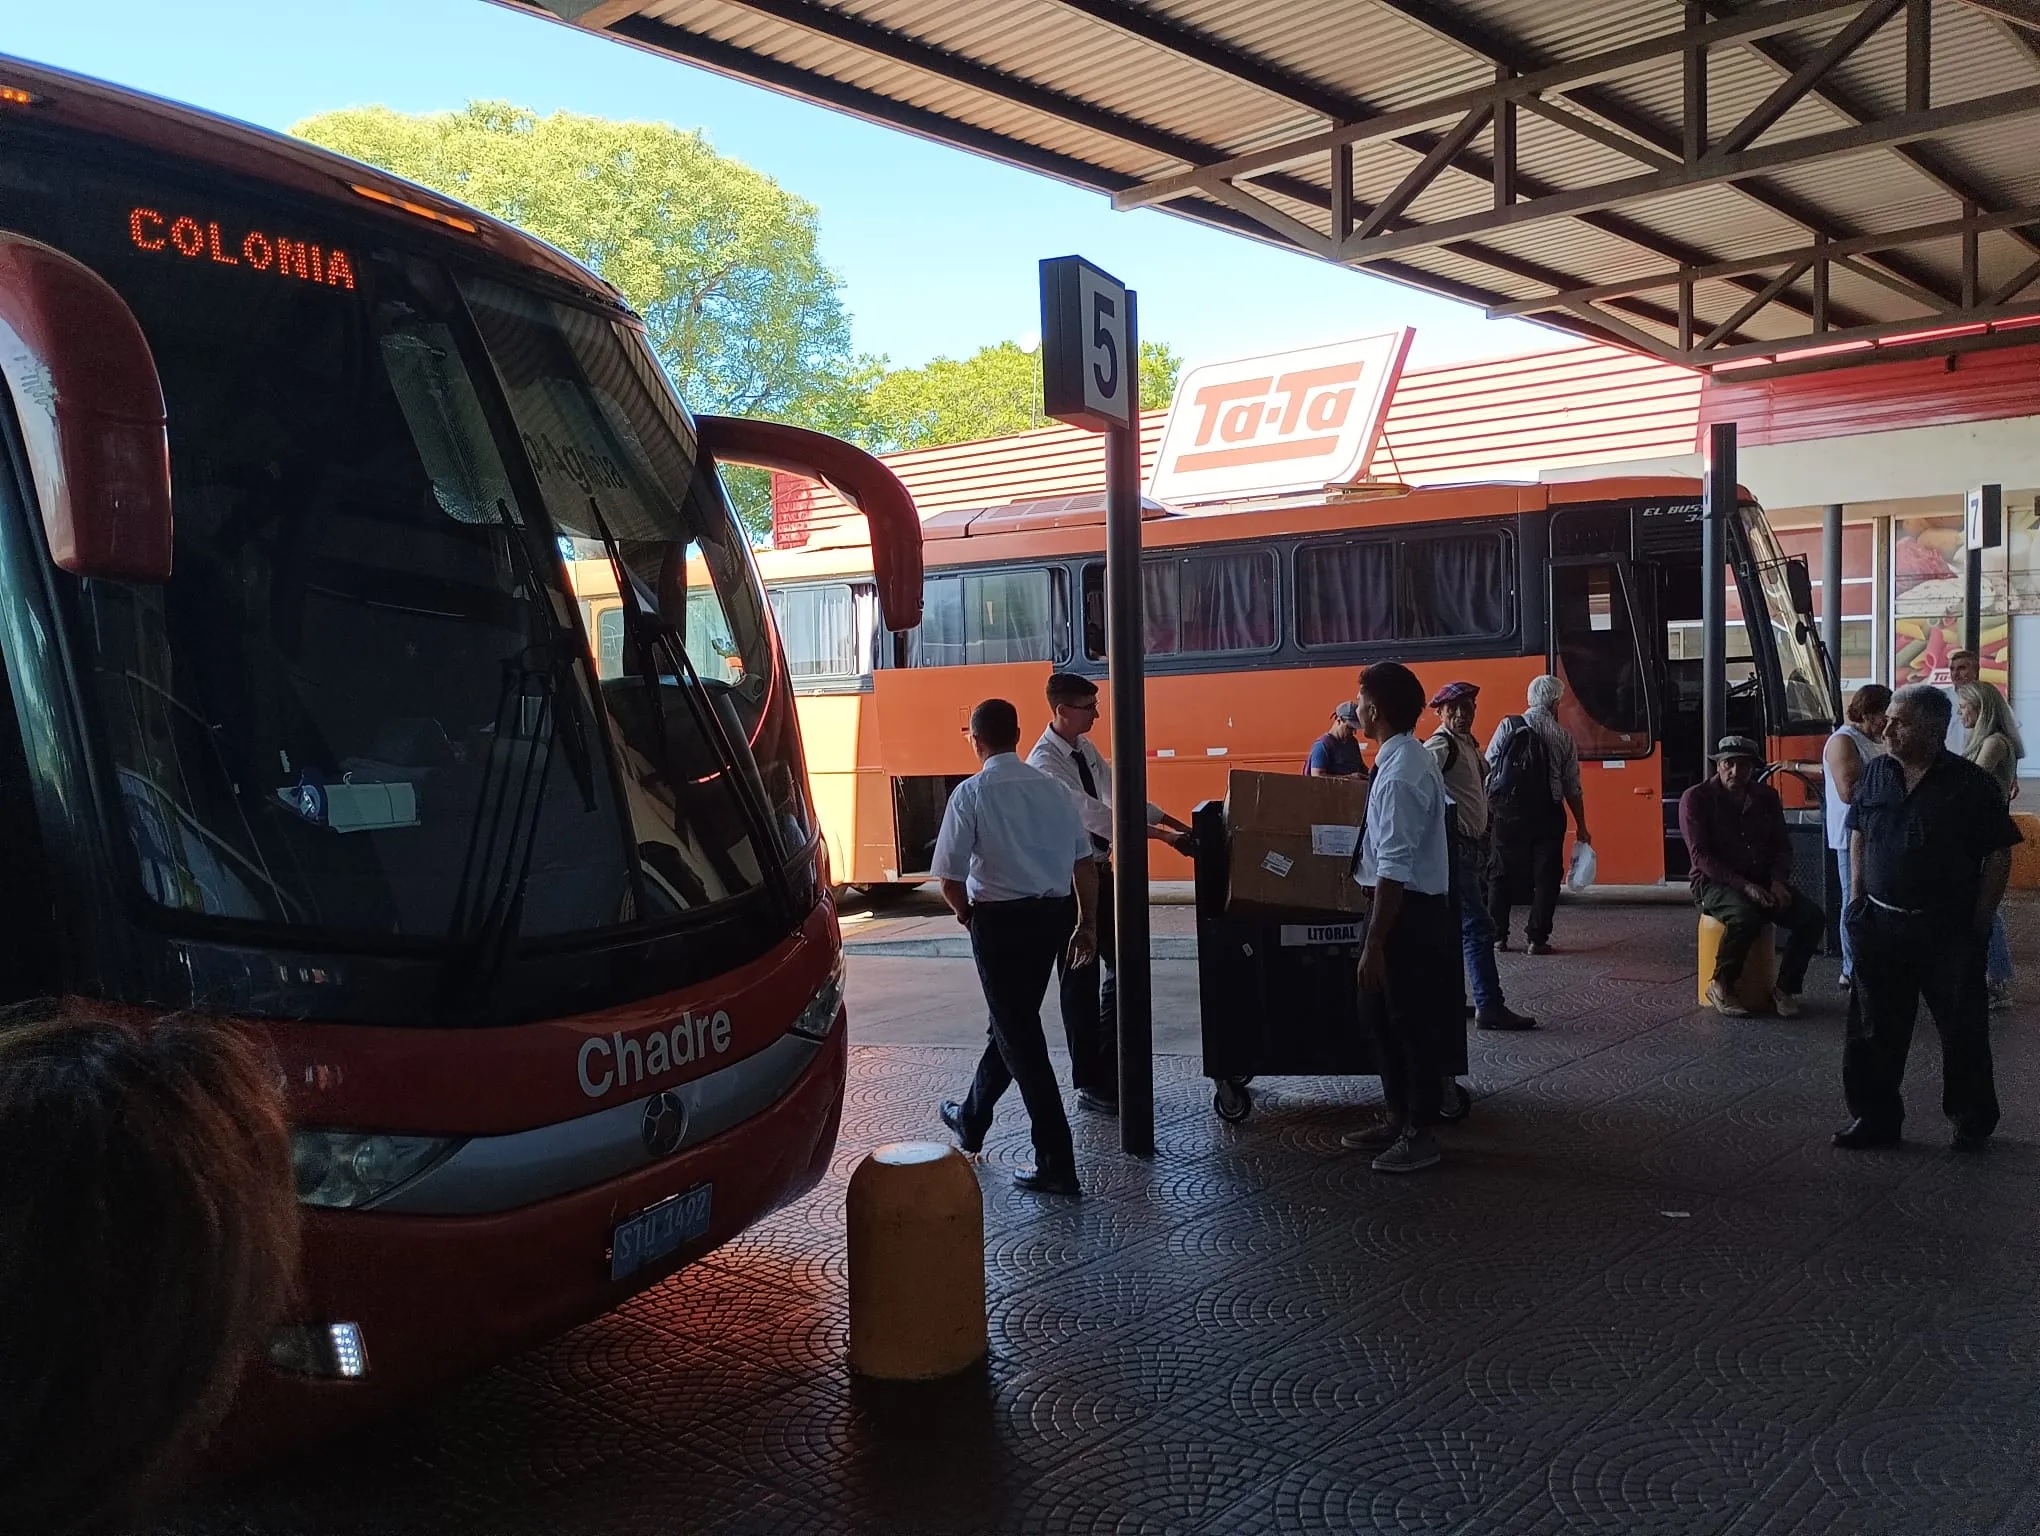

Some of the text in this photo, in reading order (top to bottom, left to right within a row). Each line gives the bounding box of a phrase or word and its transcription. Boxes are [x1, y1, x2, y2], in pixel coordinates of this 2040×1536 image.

[129, 206, 356, 289] COLONIA
[1093, 290, 1118, 399] 5
[1193, 361, 1366, 447] Ta-Ta
[1642, 507, 1664, 517] EL
[1969, 497, 1979, 540] 7
[1307, 926, 1357, 941] LITORAL
[577, 1009, 732, 1098] Chadre
[663, 1191, 708, 1239] 1492
